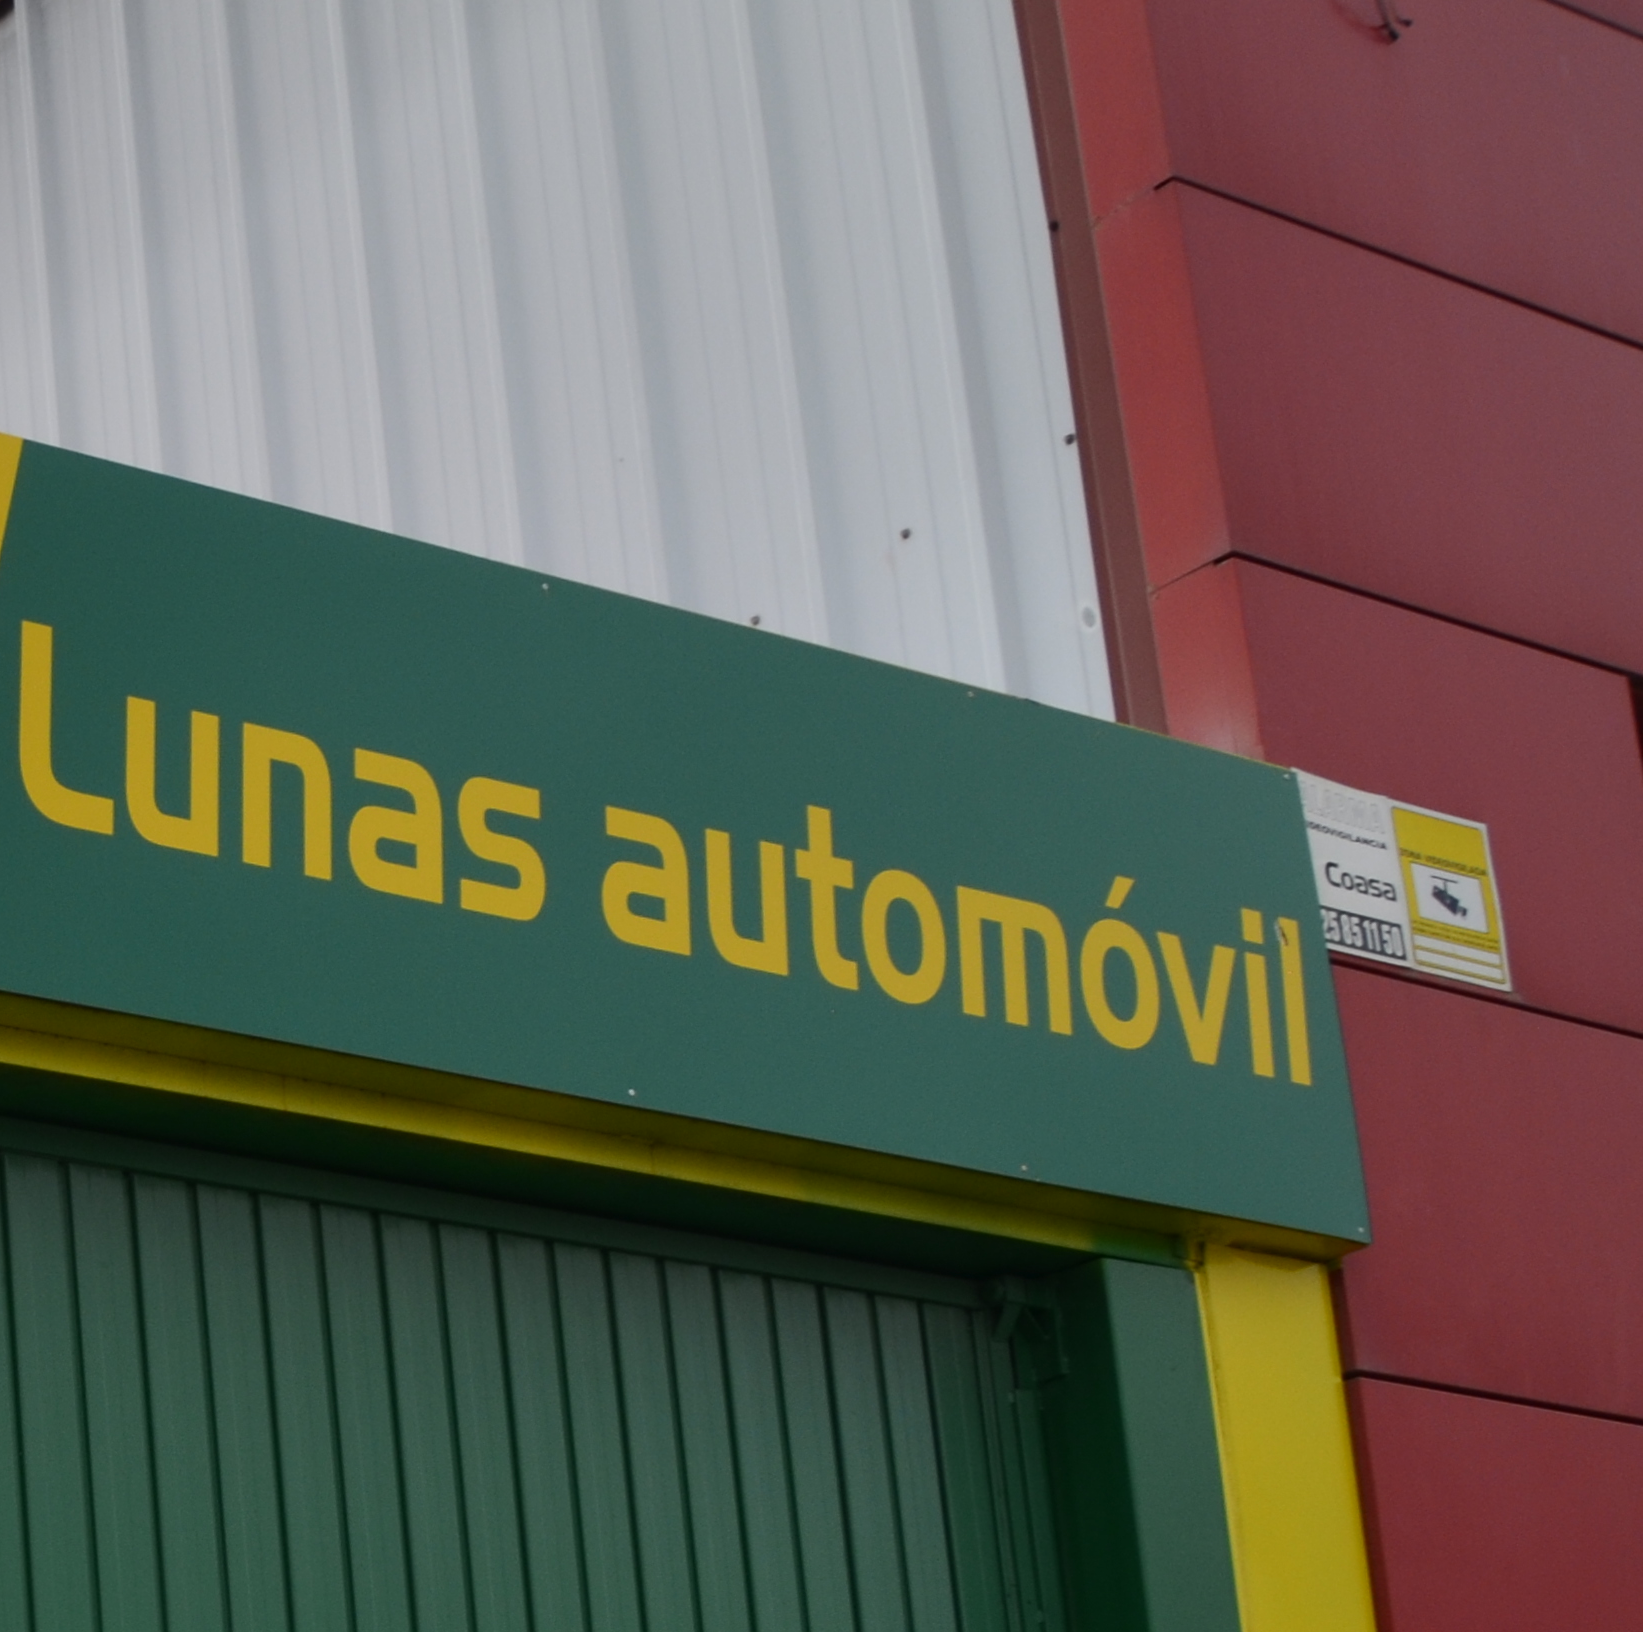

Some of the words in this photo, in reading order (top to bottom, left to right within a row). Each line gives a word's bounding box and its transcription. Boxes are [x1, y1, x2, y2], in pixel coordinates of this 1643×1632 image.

[20, 621, 545, 920] Lunas
[603, 806, 1311, 1085] automóvil
[1325, 862, 1397, 902] Coasa
